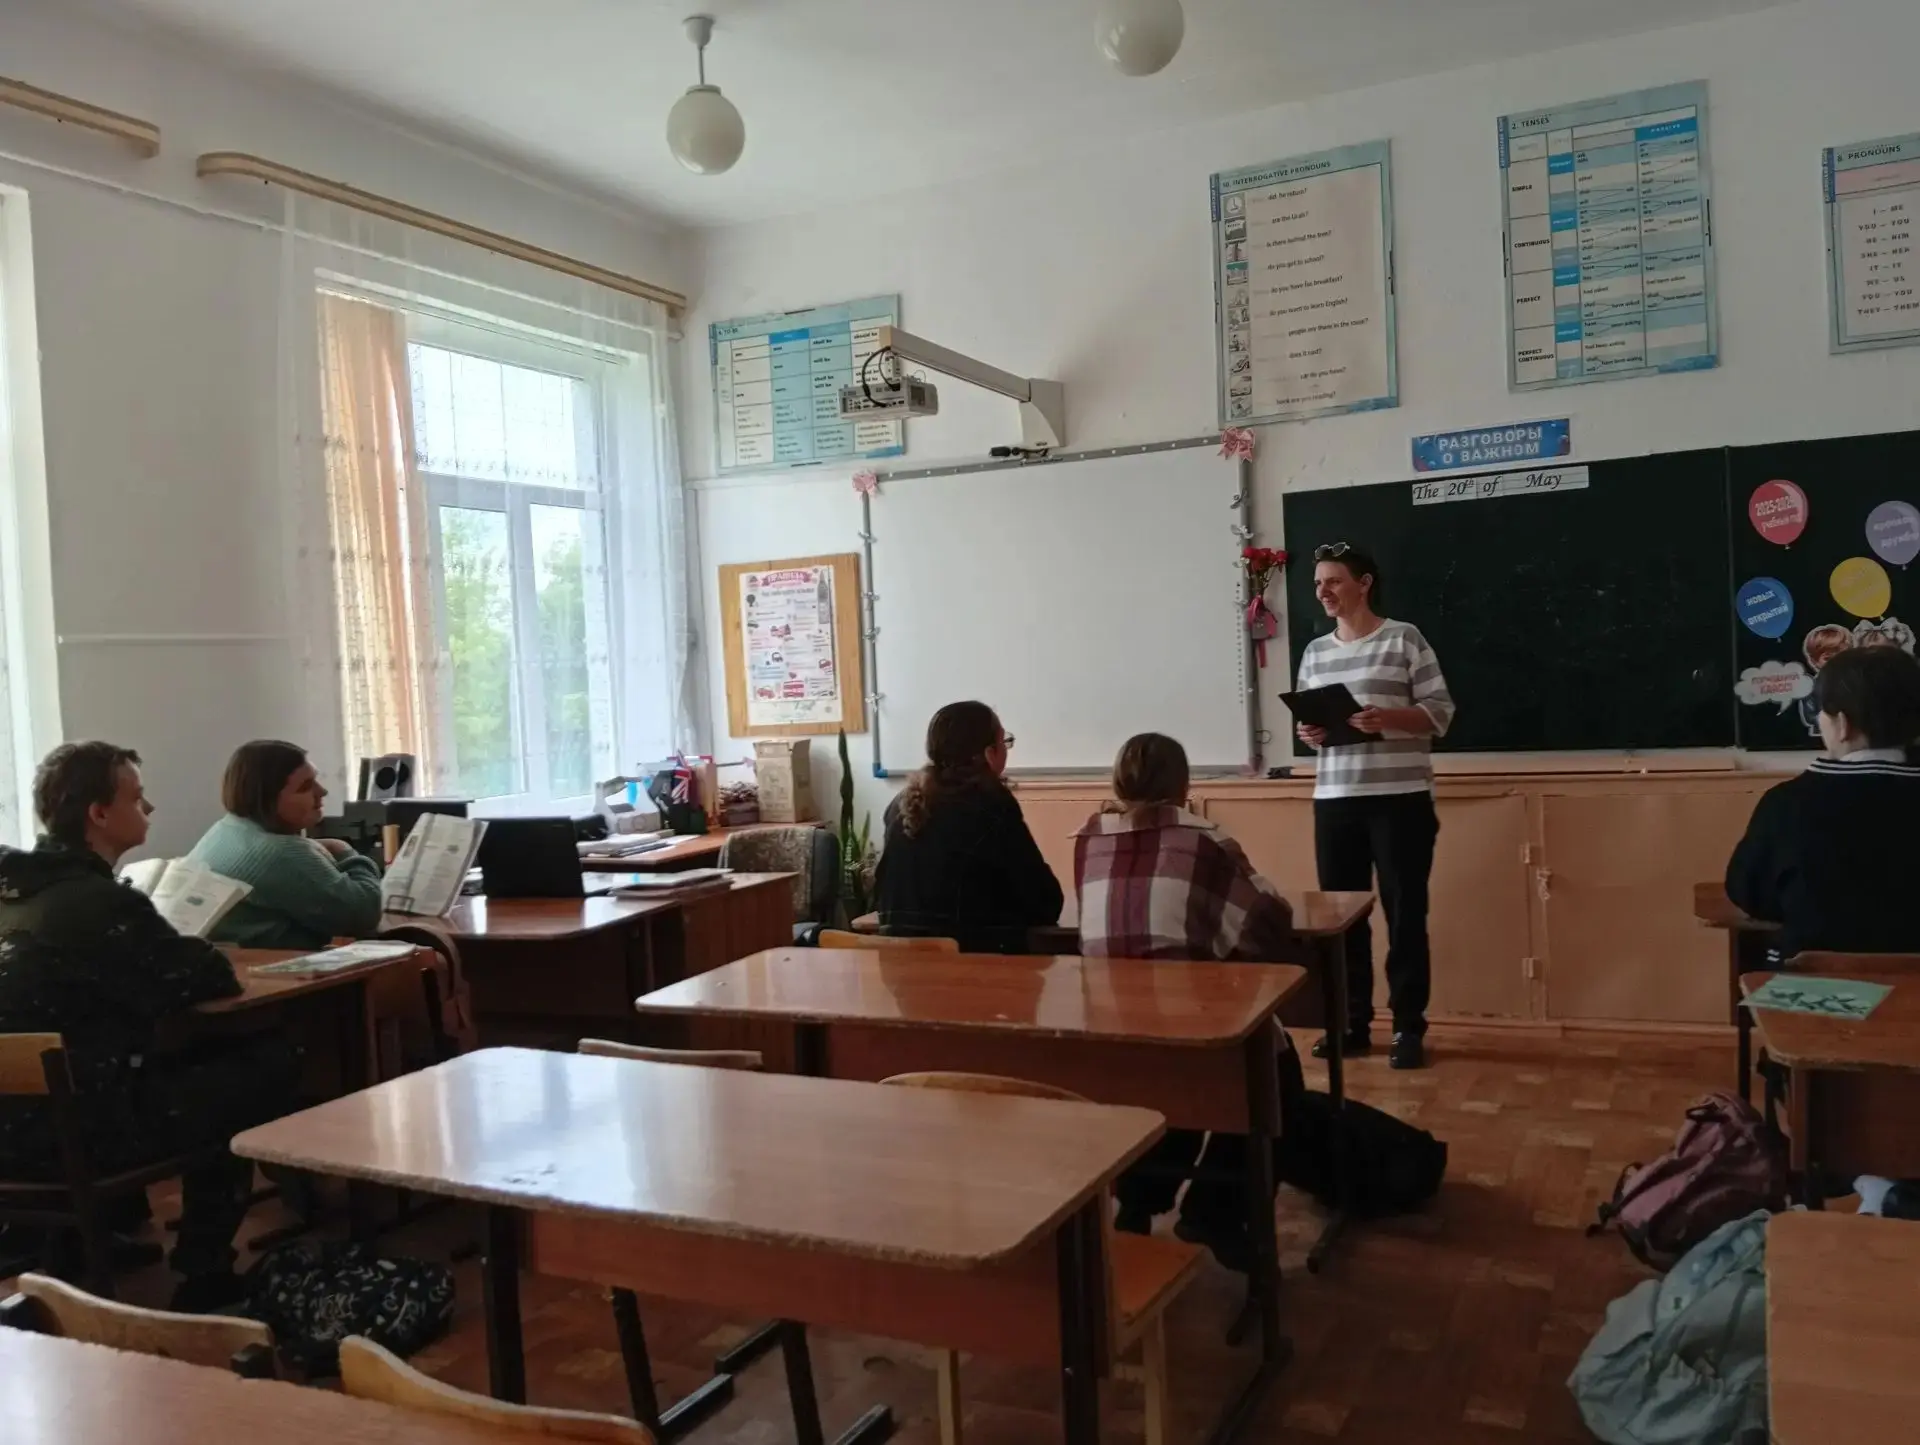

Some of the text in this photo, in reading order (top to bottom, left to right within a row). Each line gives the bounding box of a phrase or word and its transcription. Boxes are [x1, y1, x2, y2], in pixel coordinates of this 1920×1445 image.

[1521, 117, 1549, 128] TENSES
[1848, 145, 1901, 160] PRONOUNS
[1232, 169, 1289, 186] INTERROGATIVE
[1290, 161, 1331, 174] PRONOUNS
[1512, 184, 1532, 192] SIMPLE
[1891, 218, 1909, 226] YOU
[1514, 239, 1550, 248] CONTINUOUS
[1894, 289, 1913, 297] YOU
[1516, 295, 1541, 304] PERFECT
[1857, 302, 1920, 315] THEY THEM
[1518, 348, 1542, 356] PERFECT
[1518, 354, 1554, 363] CONTINUOUS
[1438, 426, 1542, 451] РАЗГОВОРЫ
[1443, 442, 1539, 465] О ВАЖНОМ
[1413, 472, 1562, 500] The 20th of May
[1747, 602, 1789, 625] открытий
